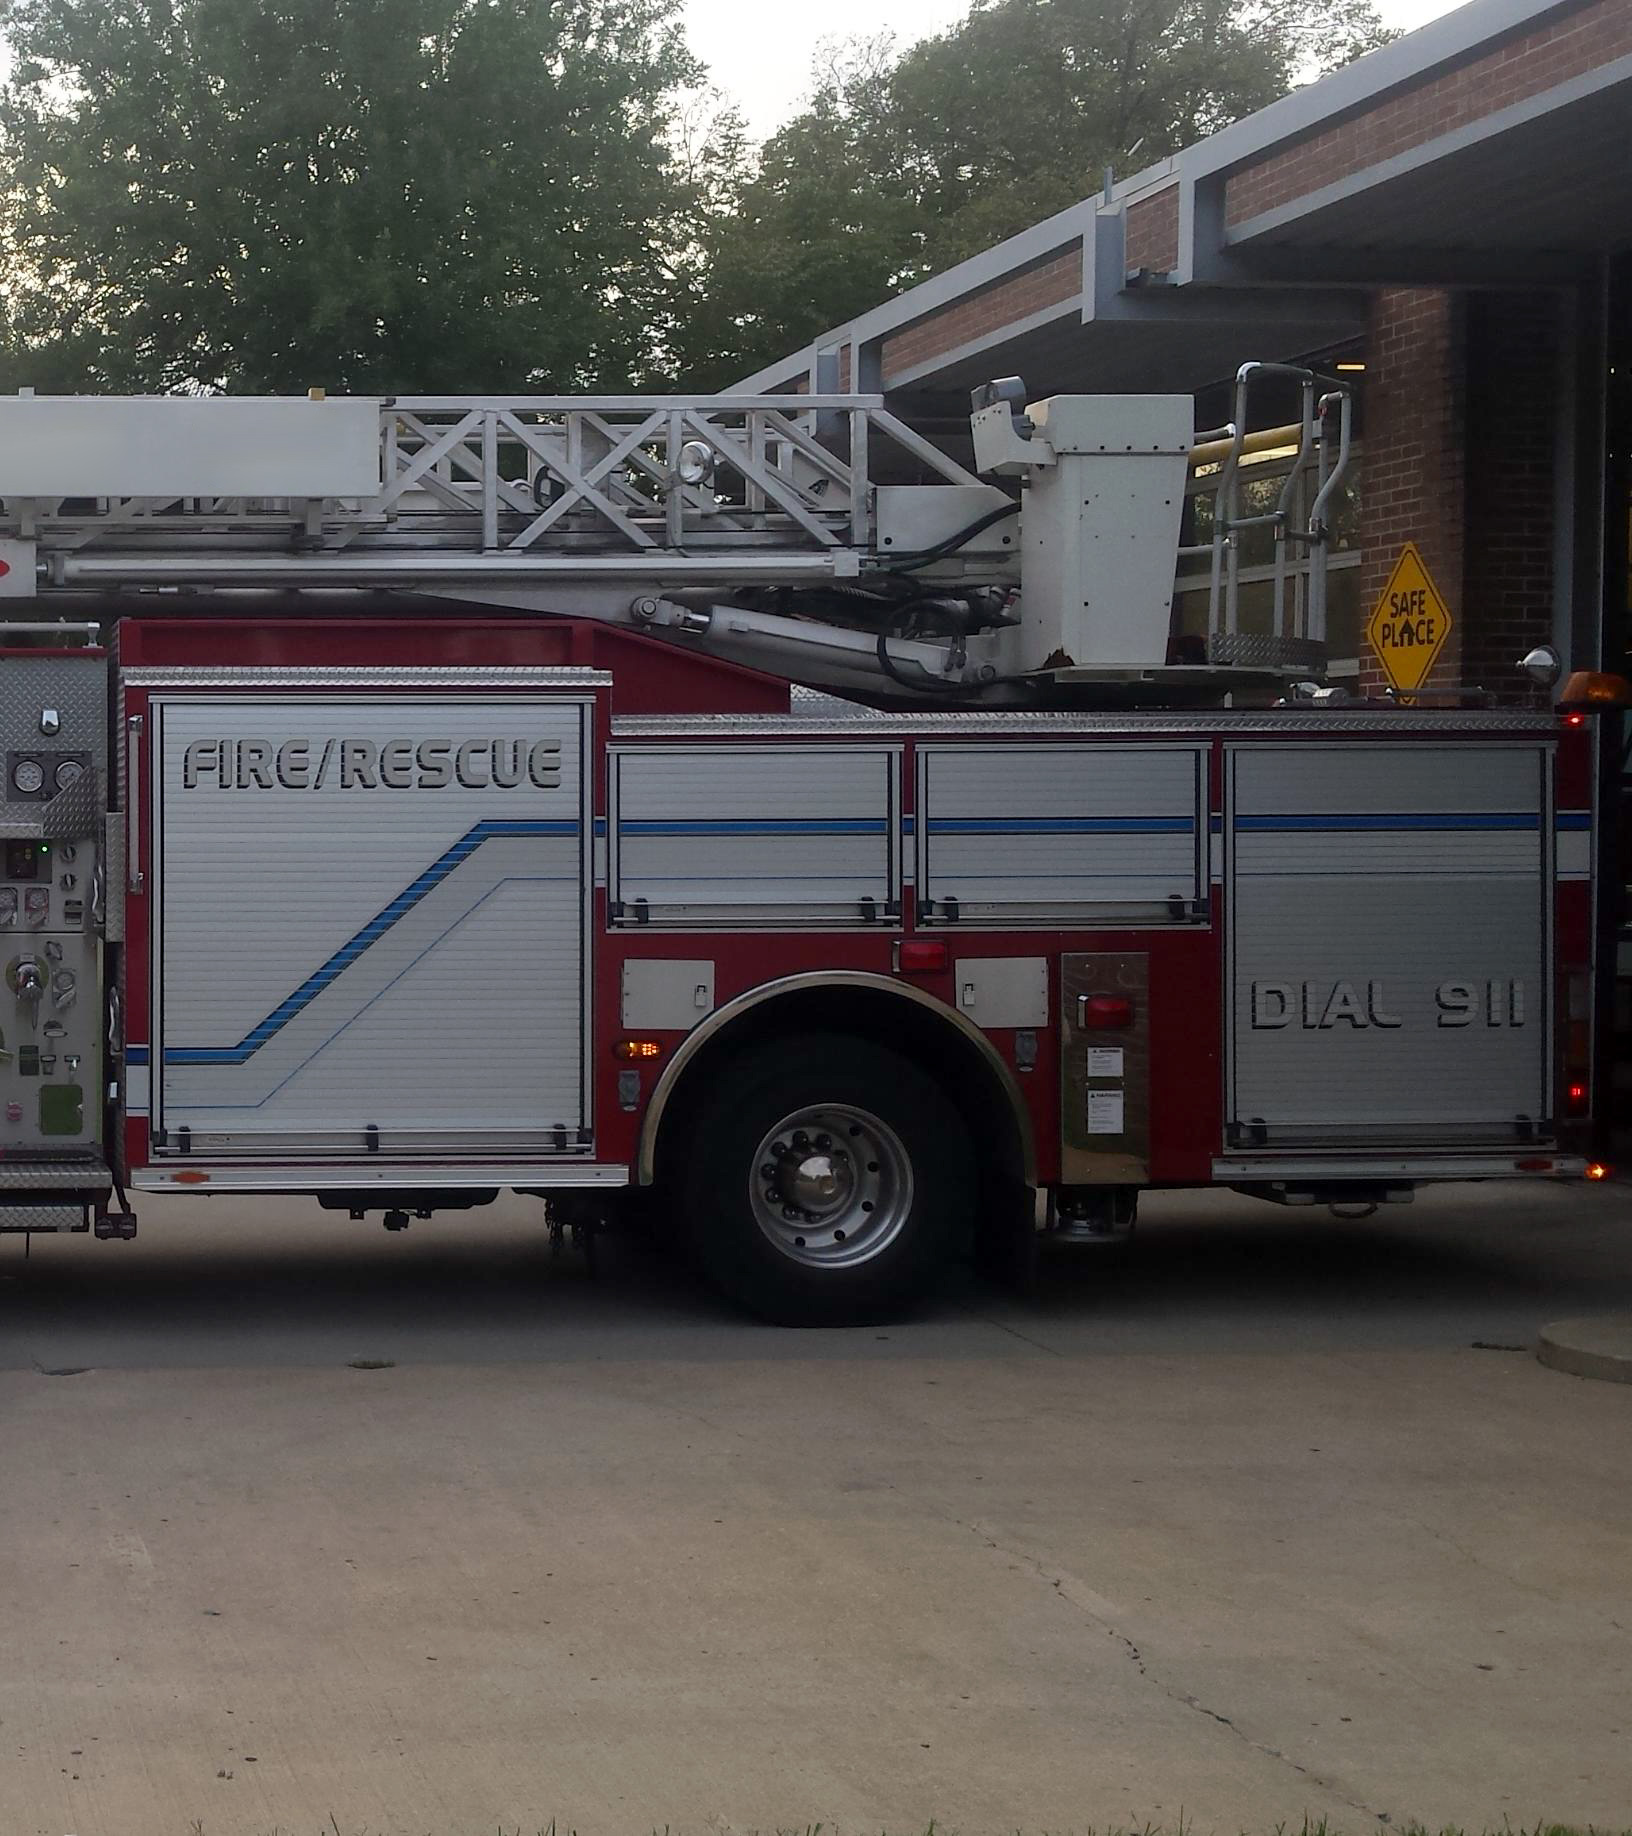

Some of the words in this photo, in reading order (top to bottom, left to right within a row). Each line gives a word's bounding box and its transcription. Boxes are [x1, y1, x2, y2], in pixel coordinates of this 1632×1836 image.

[1390, 589, 1426, 618] SAFE
[1382, 618, 1435, 648] PLACE
[184, 738, 561, 790] FIRE/RESCUE
[1251, 979, 1402, 1030] DIAL
[1434, 979, 1526, 1029] 911
